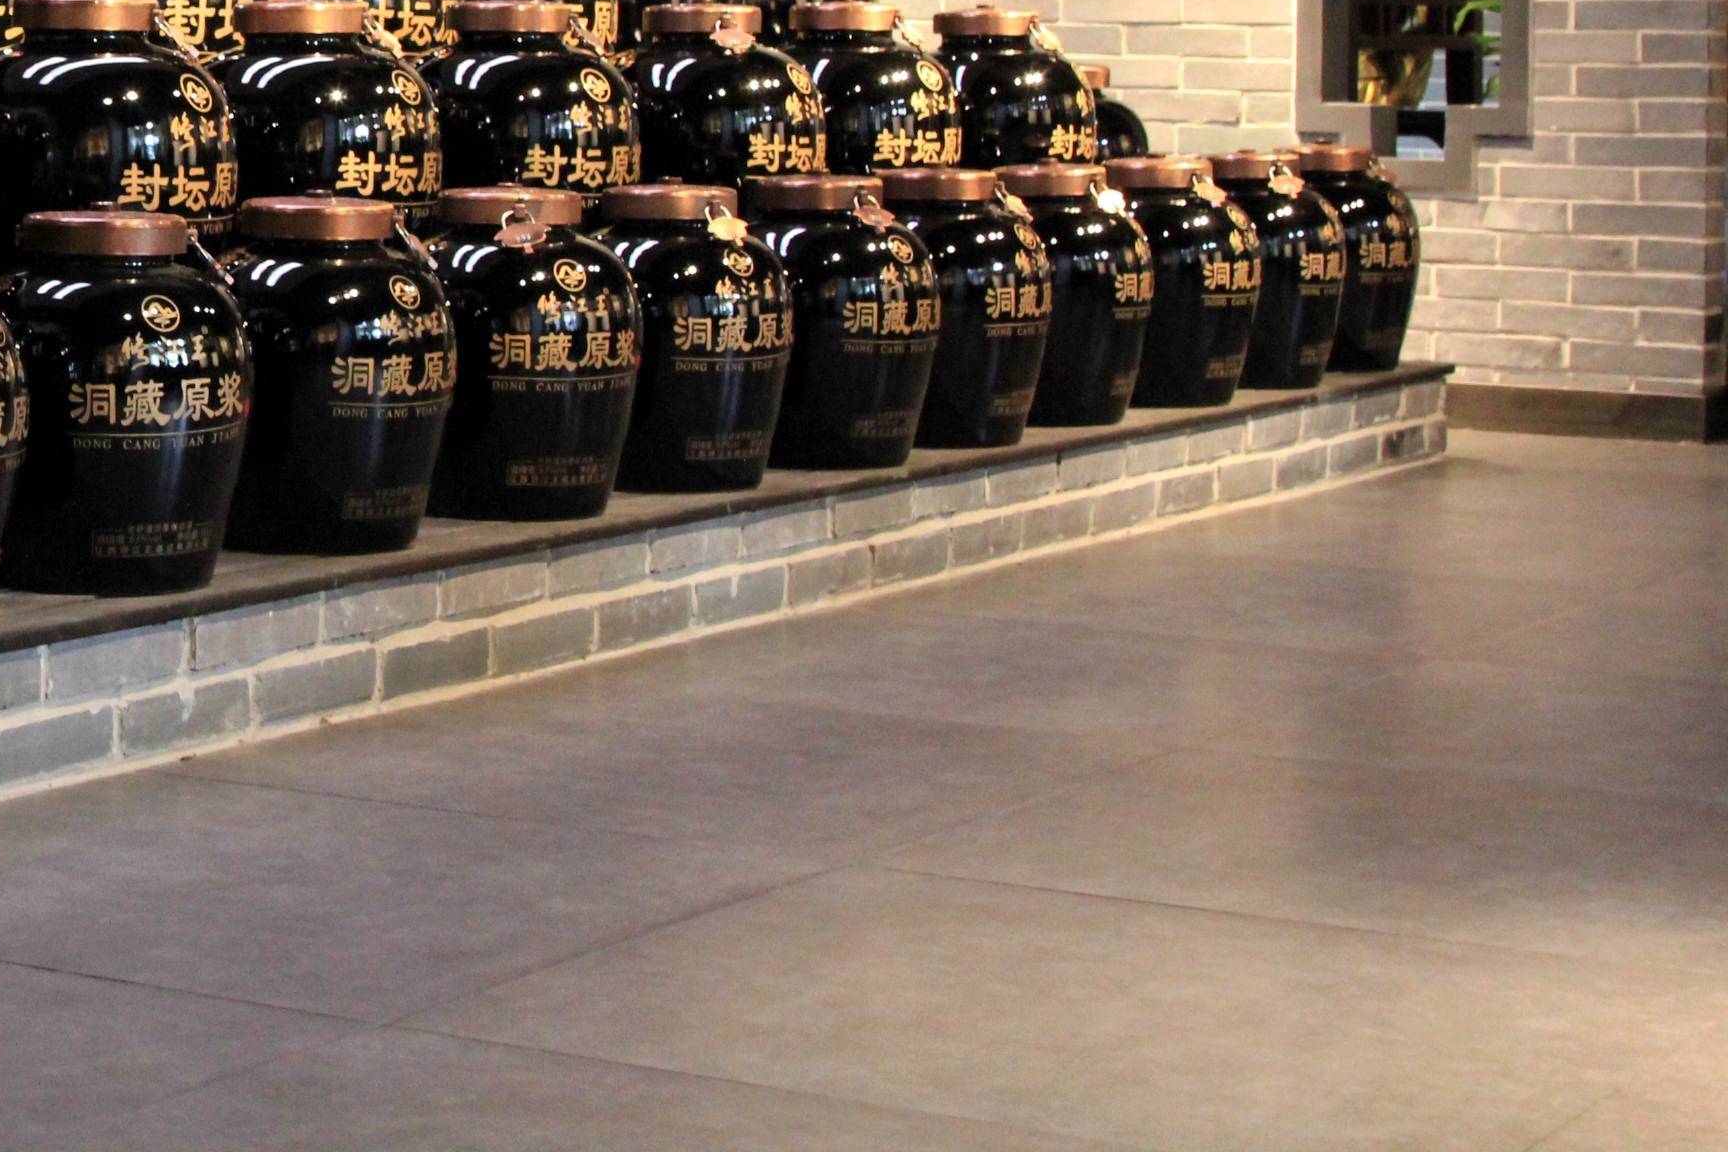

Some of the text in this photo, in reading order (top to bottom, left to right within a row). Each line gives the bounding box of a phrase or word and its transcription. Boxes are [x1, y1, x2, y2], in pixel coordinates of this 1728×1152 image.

[489, 328, 636, 372] 洞藏原浆
[69, 371, 244, 426] 洞藏原浆
[73, 439, 112, 450] DONG
[122, 438, 161, 450] CANG
